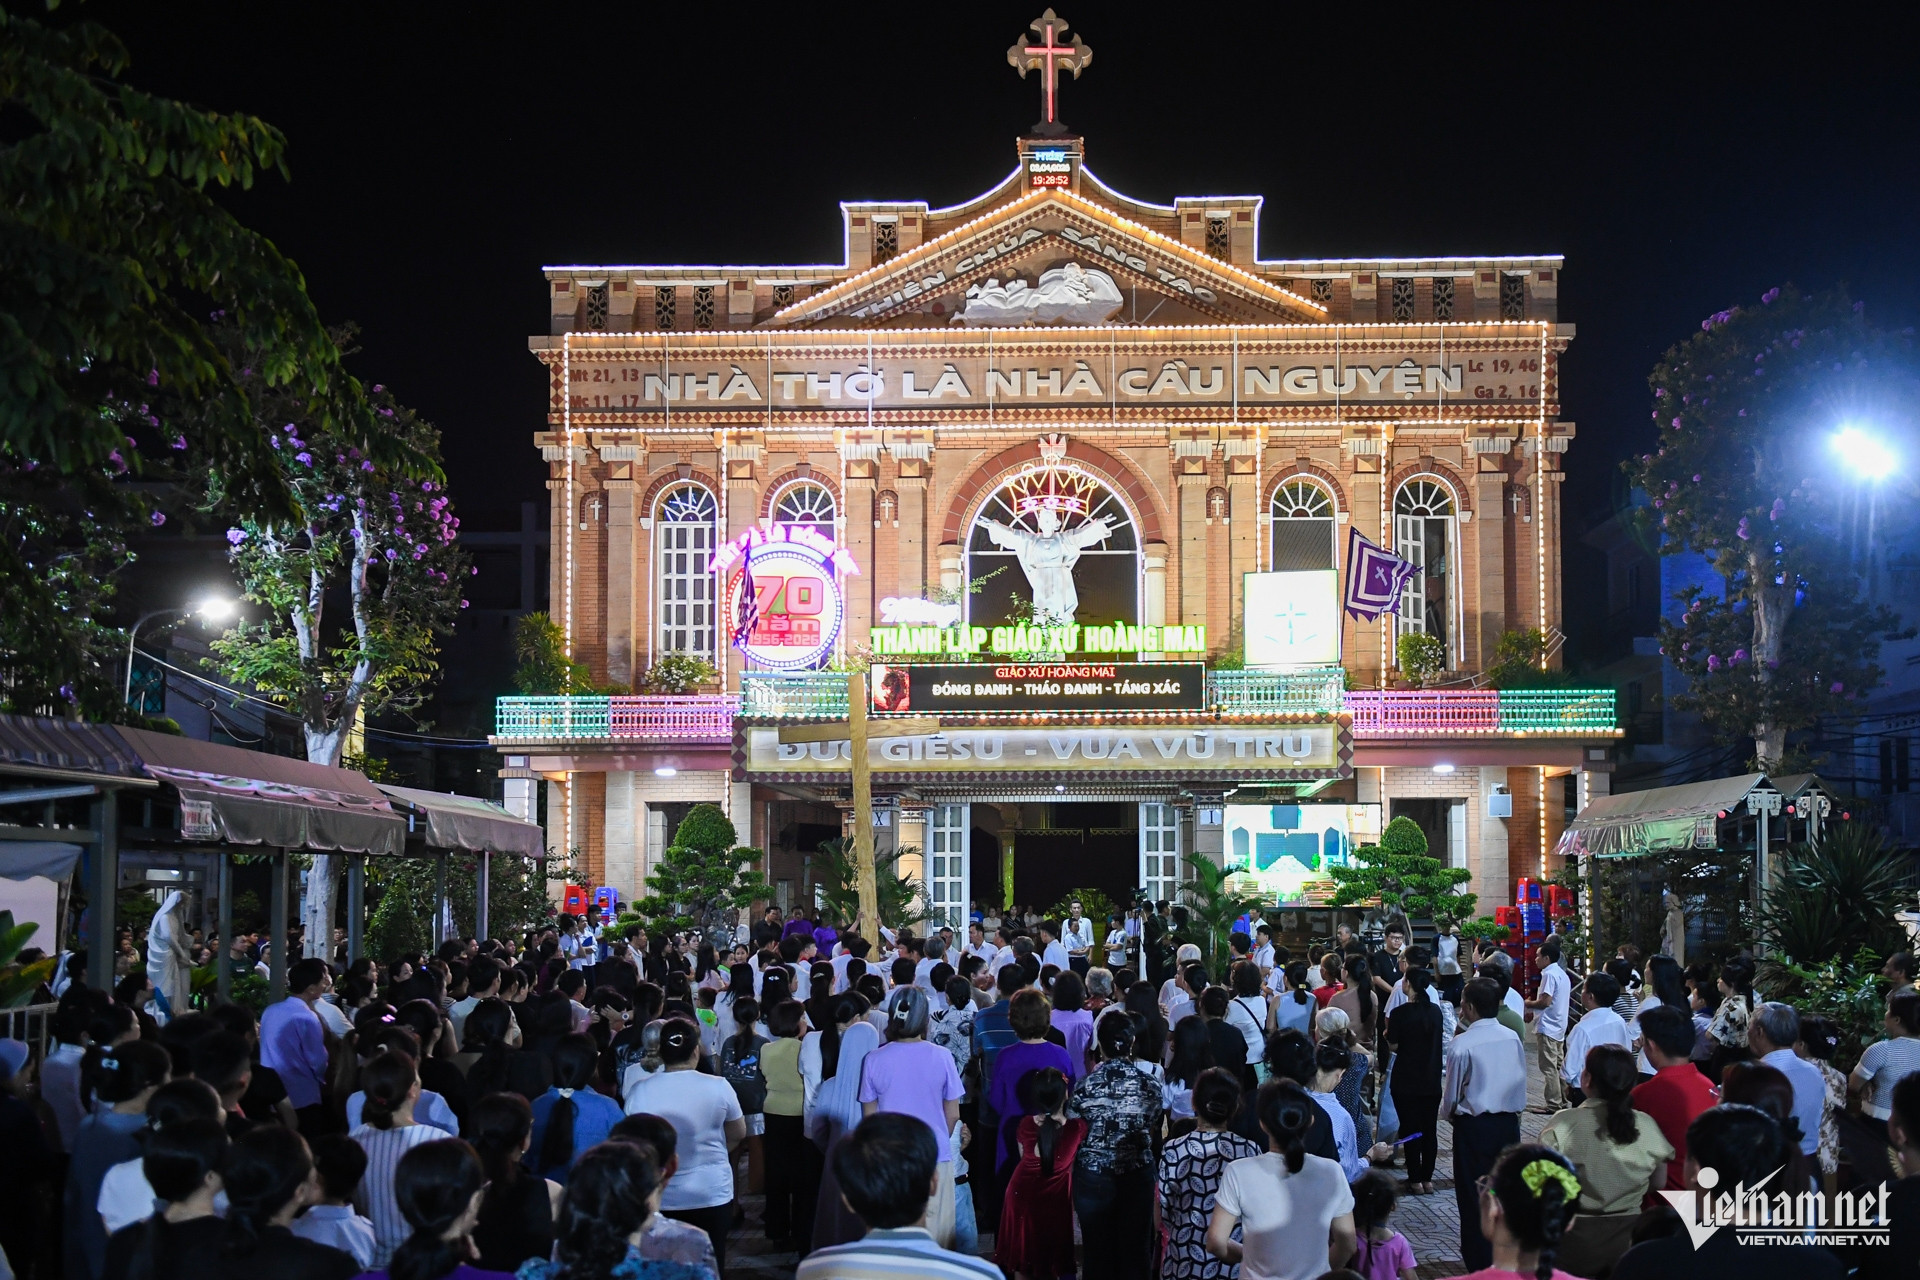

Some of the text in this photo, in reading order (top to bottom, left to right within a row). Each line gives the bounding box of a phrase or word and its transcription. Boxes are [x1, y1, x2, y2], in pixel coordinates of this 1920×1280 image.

[1033, 175, 1069, 185] 19:28:52
[850, 227, 1218, 319] THIÊN CHÚA SÁNG TẠO
[1468, 359, 1538, 374] Lc 19, 46
[569, 369, 639, 384] Mt 21, 13
[644, 358, 1464, 401] NHÀ THỜ LÀ NHÀ CẦU NGUYỆN
[1474, 385, 1538, 399] Ga 2, 16
[569, 395, 639, 411] Mc 11, 17
[754, 576, 823, 615] 70
[750, 633, 820, 646] 1956-2026
[871, 620, 1206, 659] THÀNH LẬP GIÁO XỨ HOÀNG MAI
[995, 666, 1115, 678] GIÁO XỨ HOÀNG MAI
[974, 684, 1013, 695] ĐANH
[1024, 680, 1060, 695] THÁO
[1063, 683, 1102, 695] ĐANH
[1114, 679, 1150, 695] TÁNG
[1153, 679, 1180, 694] XÁC
[1048, 737, 1142, 760] VUA
[1152, 731, 1215, 760] VŨ
[1227, 736, 1312, 766] TRỤ
